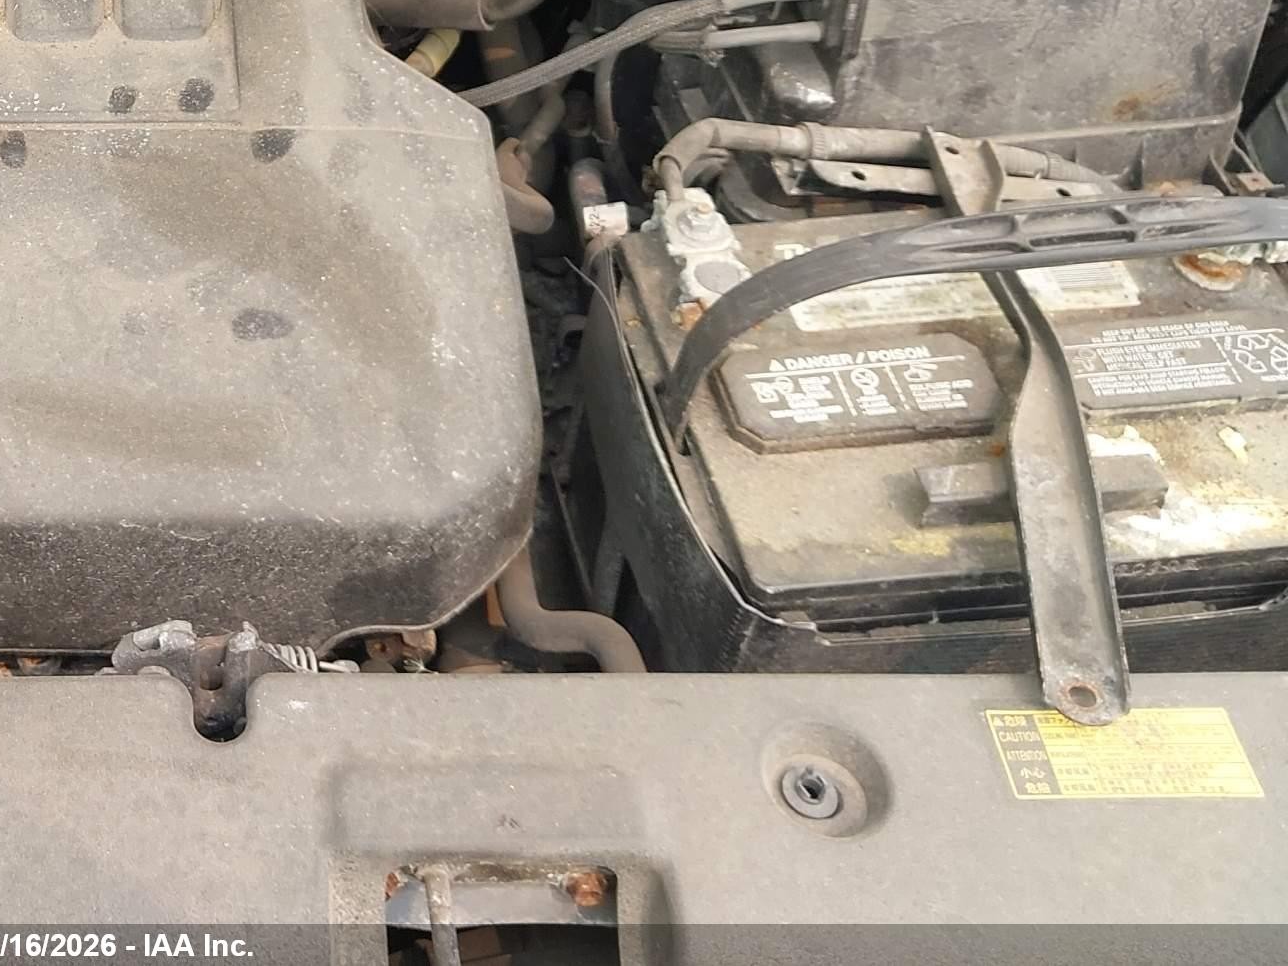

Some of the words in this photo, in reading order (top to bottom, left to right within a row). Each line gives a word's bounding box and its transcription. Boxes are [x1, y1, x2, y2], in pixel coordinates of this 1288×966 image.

[784, 354, 853, 370] DANGER
[866, 346, 931, 362] POISON
[998, 731, 1041, 743] CAUTION
